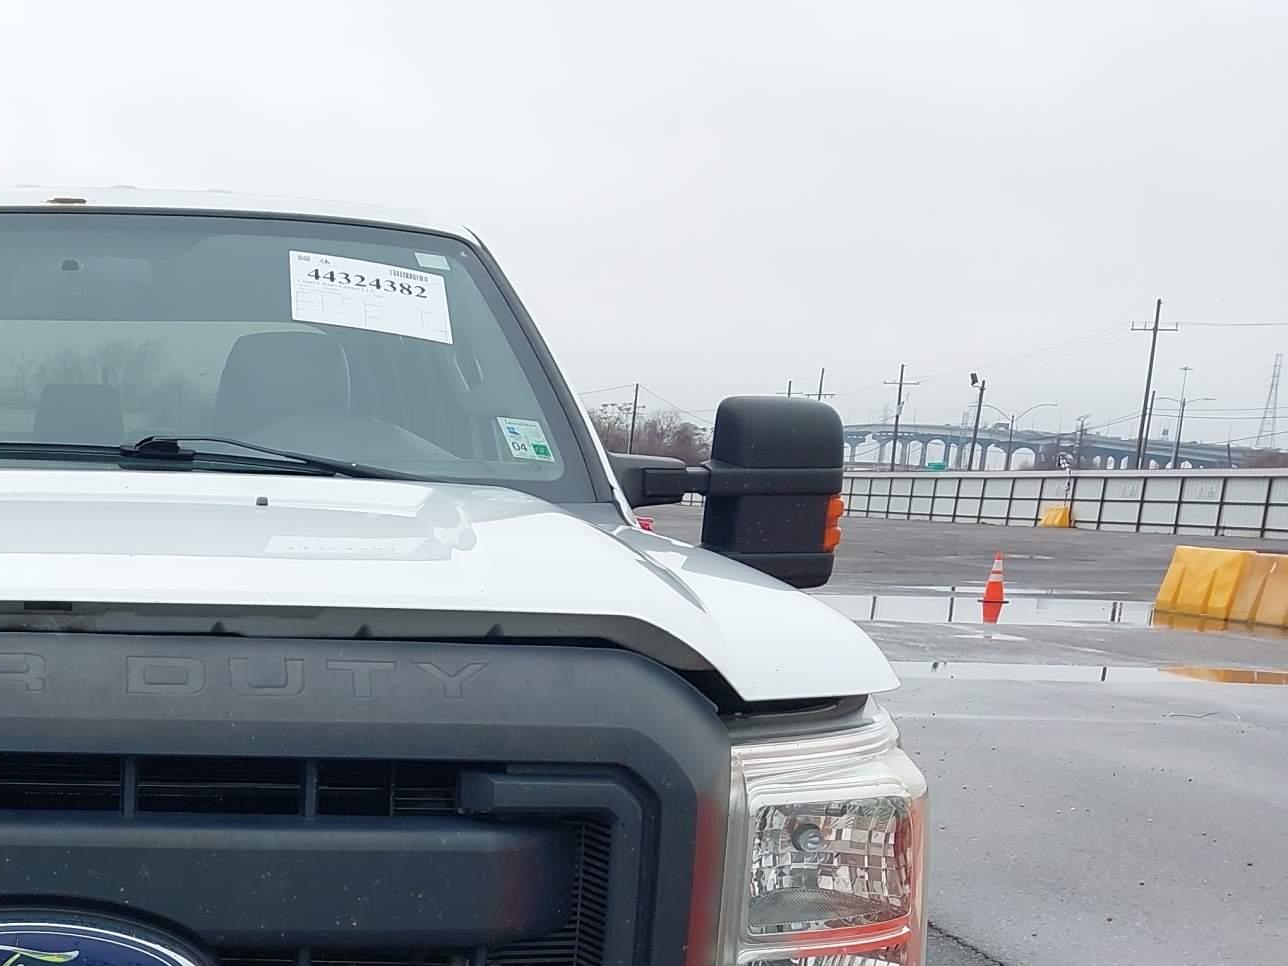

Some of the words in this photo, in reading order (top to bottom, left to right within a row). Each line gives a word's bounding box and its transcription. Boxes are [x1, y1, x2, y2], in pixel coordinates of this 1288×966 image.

[307, 268, 428, 299] 44324382
[512, 441, 528, 452] 04
[125, 655, 491, 699] DUTY
